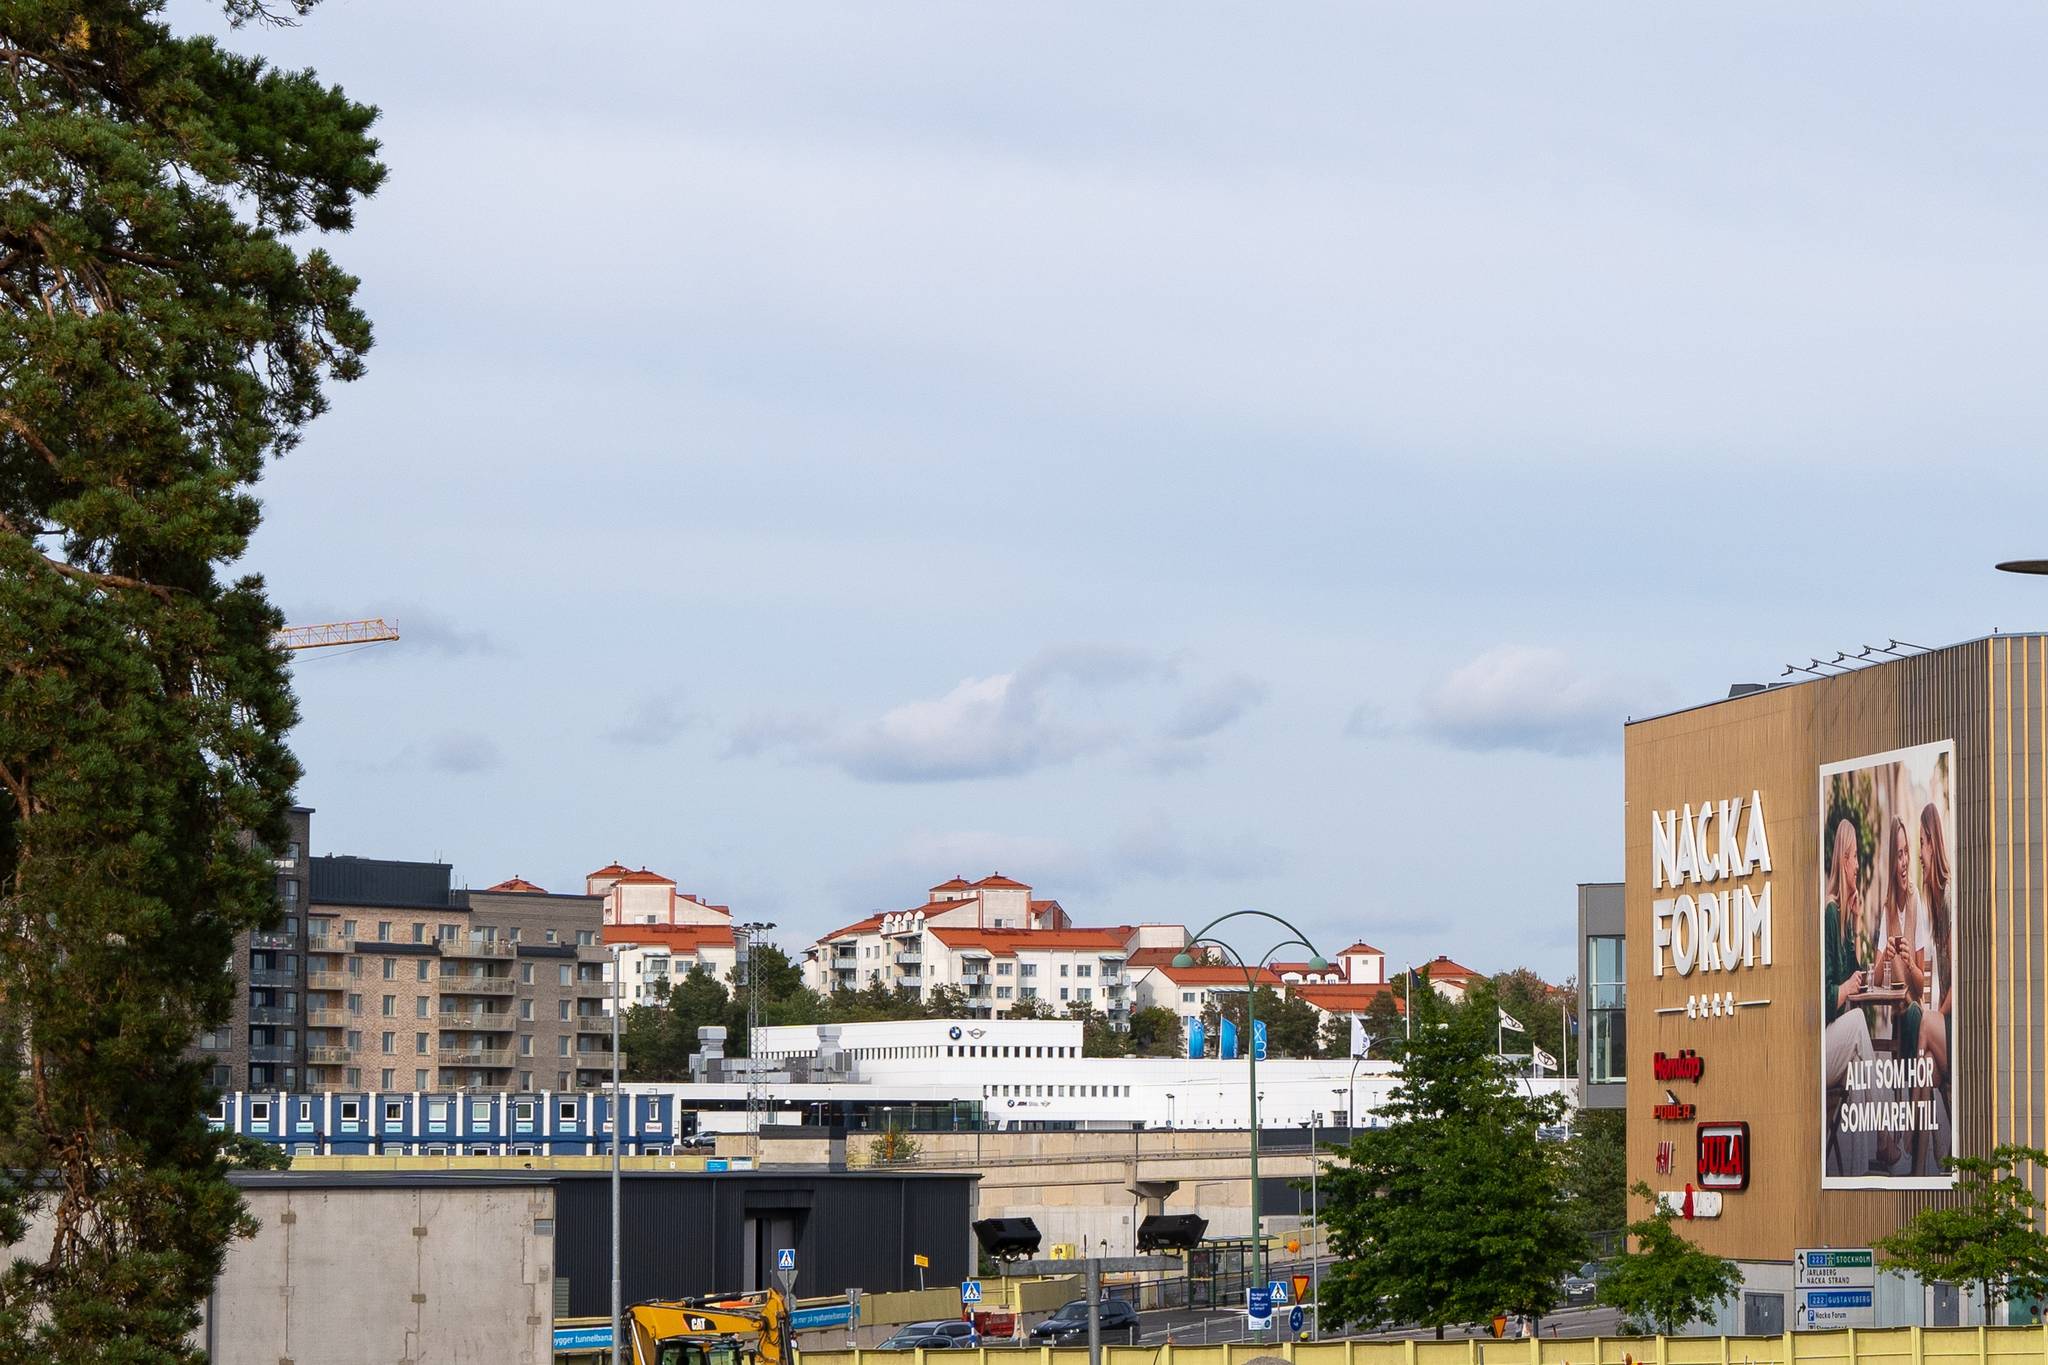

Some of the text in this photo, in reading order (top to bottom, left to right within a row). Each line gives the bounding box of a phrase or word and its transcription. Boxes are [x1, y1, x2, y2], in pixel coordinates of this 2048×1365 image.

[1652, 790, 1772, 889] NACKA
[1653, 881, 1772, 977] FORUM
[1653, 1049, 1703, 1084] Hemköp
[1845, 1049, 1934, 1091] ALLT SOM HÖR
[1653, 1104, 1695, 1120] POWER
[1840, 1100, 1939, 1133] SOMMAREN TILL
[1699, 1134, 1742, 1175] JULA
[1811, 1255, 1871, 1264] 222 STOCKHOLM
[1806, 1268, 1837, 1277] JARLABERG
[1828, 1276, 1850, 1284] STRAND
[1812, 1295, 1871, 1304] 222 GUSTAVSBERG
[1815, 1311, 1831, 1319] Nacka
[1831, 1311, 1847, 1319] Forum
[691, 1317, 706, 1331] CAT
[553, 1336, 574, 1346] ygger
